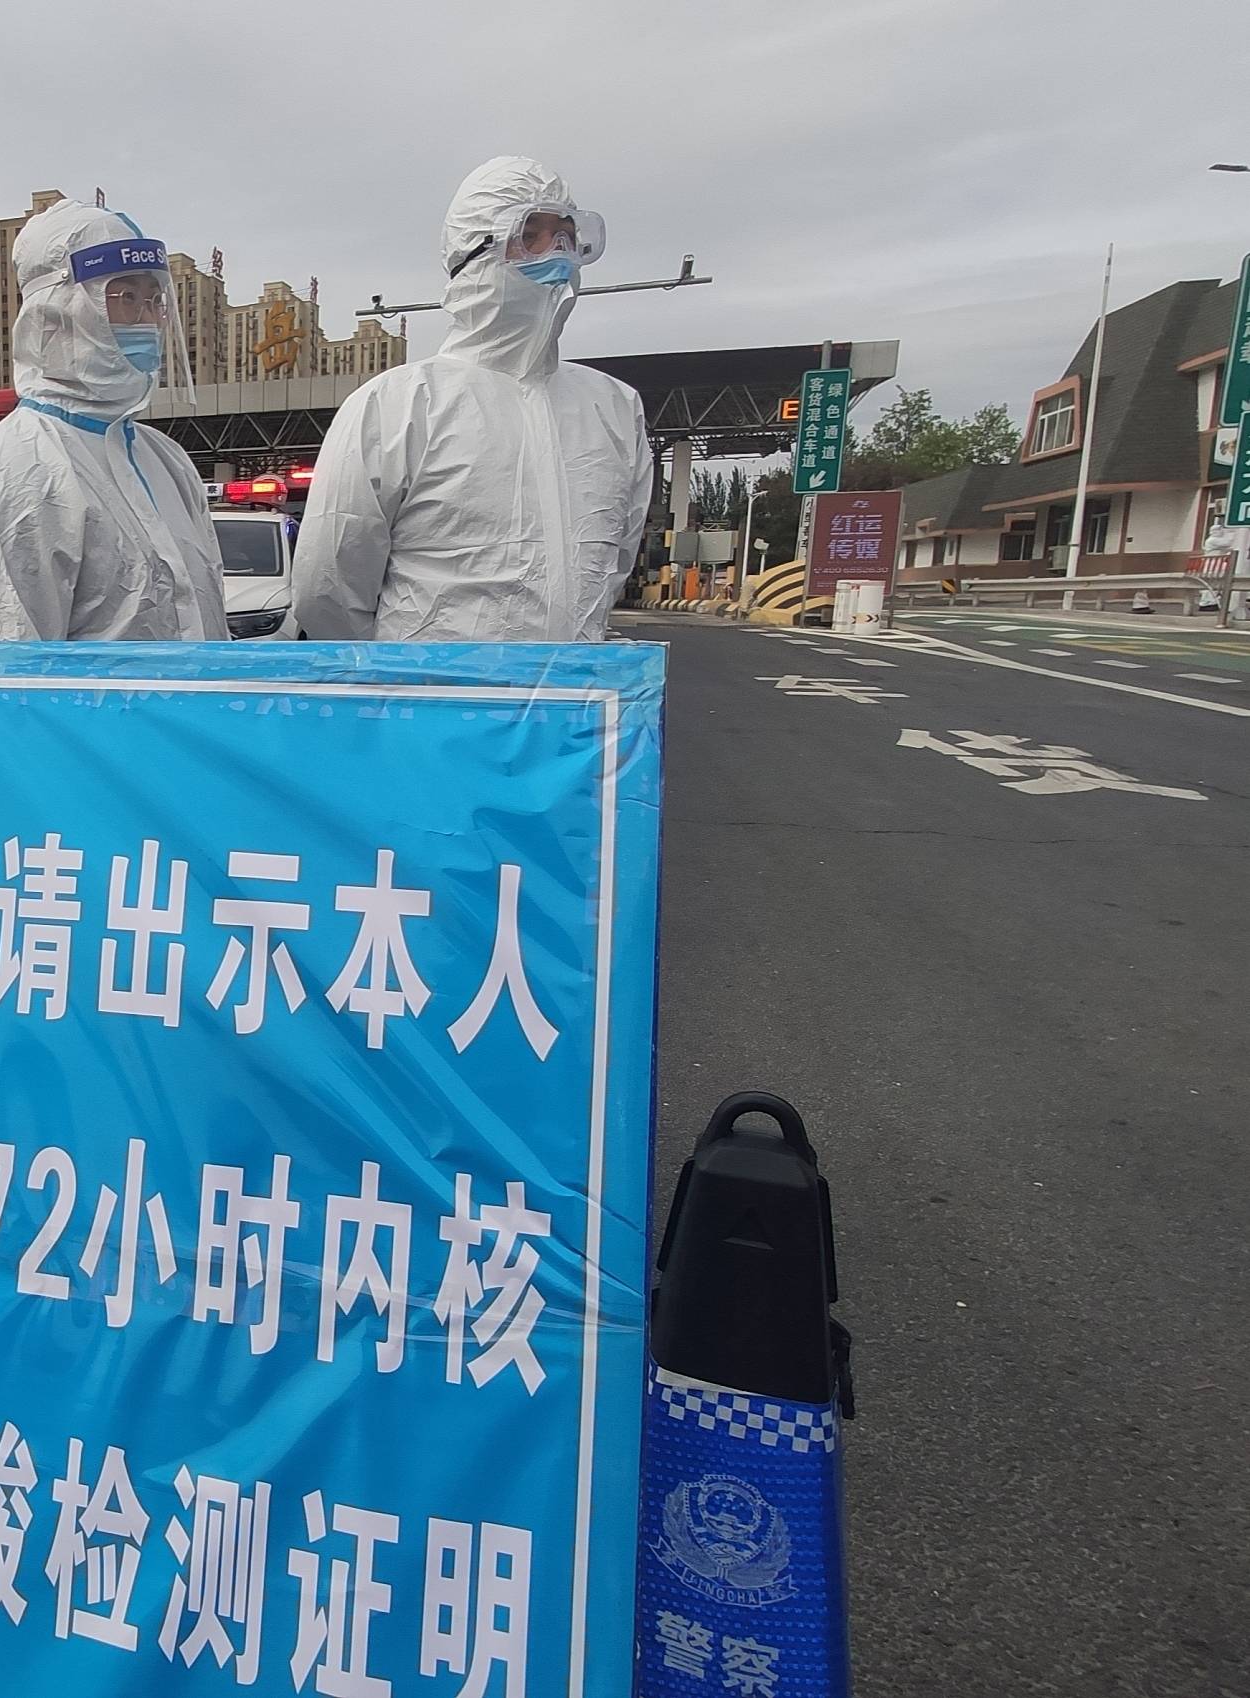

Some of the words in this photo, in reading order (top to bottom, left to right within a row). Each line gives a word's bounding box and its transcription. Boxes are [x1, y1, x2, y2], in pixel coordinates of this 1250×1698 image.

[120, 248, 155, 264] Face
[801, 377, 825, 468] 客货混合车道
[821, 383, 844, 460] 绿色通道
[830, 514, 883, 535] 红运
[654, 1609, 779, 1698] 警察
